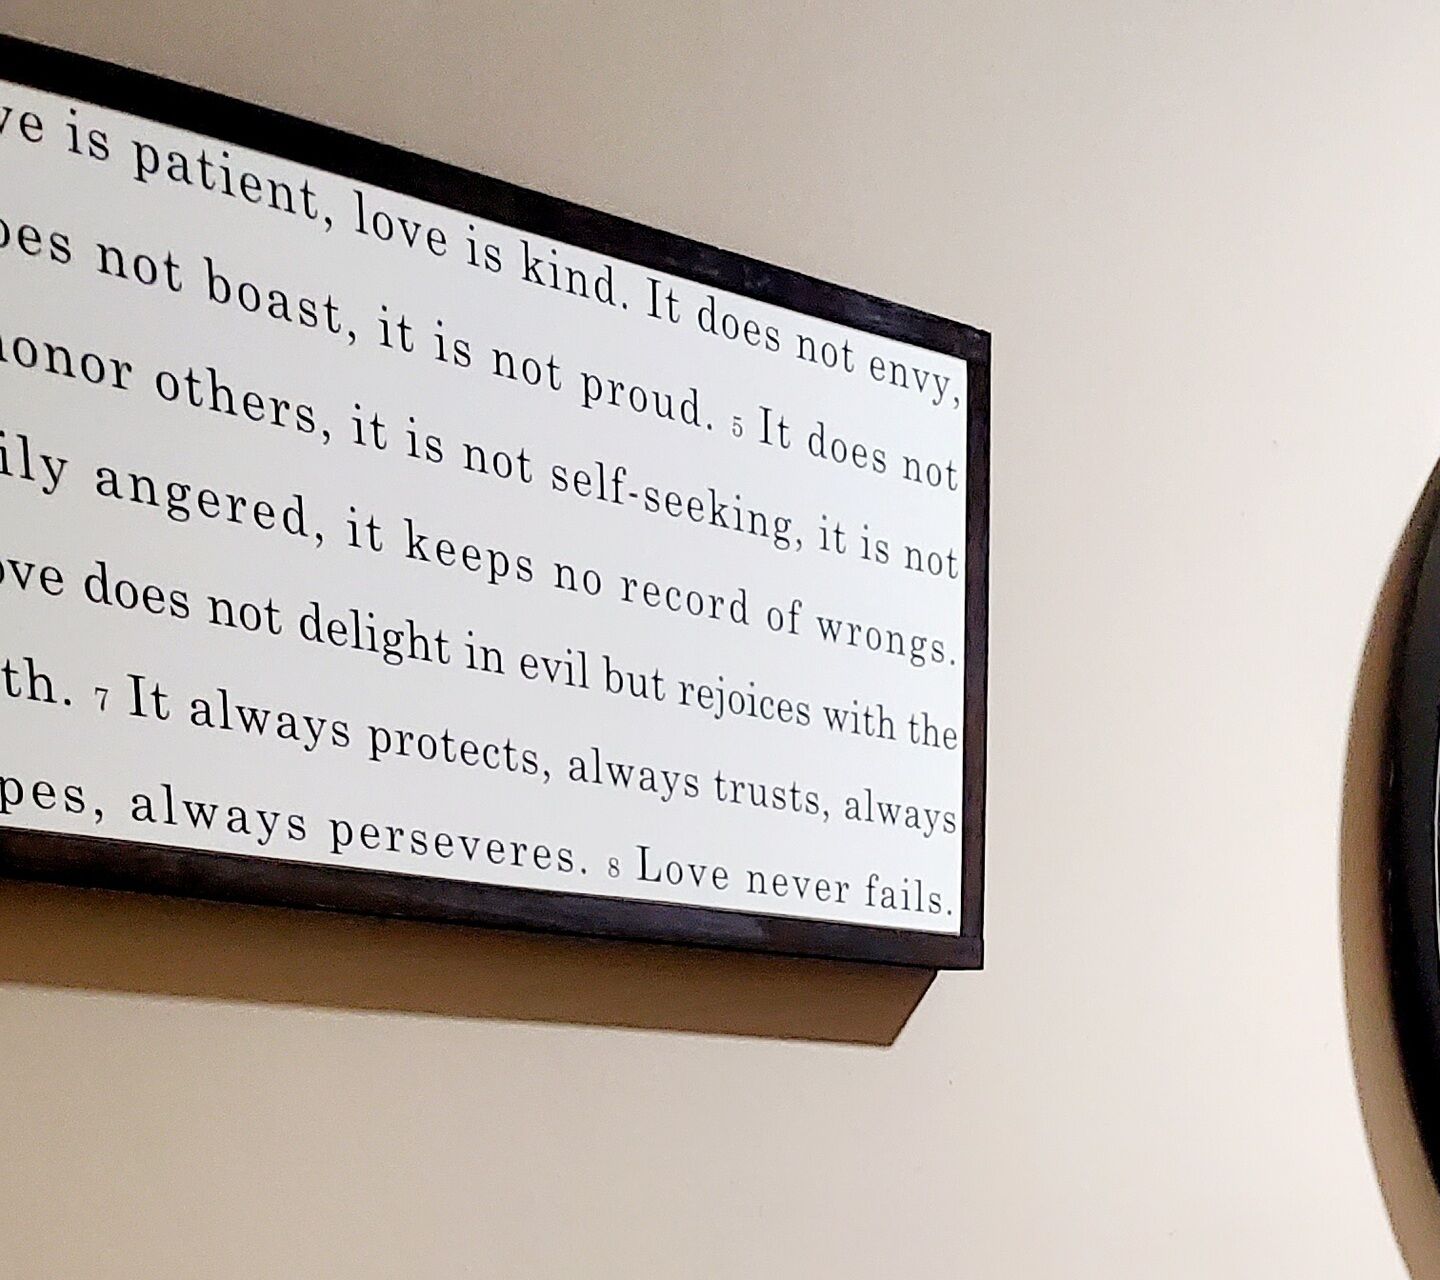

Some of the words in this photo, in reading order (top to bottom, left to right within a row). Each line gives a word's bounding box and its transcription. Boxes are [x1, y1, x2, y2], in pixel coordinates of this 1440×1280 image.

[65, 107, 110, 162] is
[131, 140, 333, 233] patient,
[352, 189, 447, 257] love
[466, 224, 502, 273] is
[519, 239, 628, 310] kind.
[646, 276, 681, 324] It
[697, 294, 780, 352] does
[796, 334, 854, 373] not
[869, 356, 960, 407] envy,
[0, 335, 133, 391] onor
[155, 366, 330, 446] others,
[351, 403, 388, 451] it
[406, 416, 444, 464] is
[462, 443, 533, 484] not
[551, 460, 802, 552] self-seeking,
[820, 514, 845, 554] it
[861, 524, 889, 564] is
[905, 546, 957, 579] not
[95, 243, 183, 293] not
[203, 255, 356, 346] boast,
[378, 304, 414, 353] it
[434, 319, 471, 368] is
[491, 348, 562, 391] not
[580, 372, 712, 431] proud.
[732, 415, 743, 438] 5
[759, 405, 791, 449] It
[808, 421, 887, 474] does
[903, 456, 957, 491] not
[0, 558, 64, 597] ve
[84, 560, 190, 619] does
[207, 596, 283, 635] not
[299, 601, 451, 666] delight
[464, 630, 505, 675] in
[520, 648, 590, 689] evil
[602, 654, 666, 702] but
[678, 675, 810, 726] rejoices
[823, 700, 896, 740] with
[908, 712, 957, 750] the
[96, 467, 324, 549] angered,
[346, 505, 383, 552] it
[403, 517, 533, 586] keeps
[554, 562, 602, 596] no
[620, 576, 749, 626] record
[767, 599, 803, 635] of
[816, 616, 955, 667] wrongs.
[0, 656, 72, 707] th.
[94, 686, 109, 712] 7
[126, 673, 170, 721] It
[190, 687, 350, 752] always
[367, 725, 550, 784] protects,
[569, 747, 699, 803] always
[714, 770, 829, 819] trusts,
[845, 788, 956, 839] always
[0, 775, 103, 825] pes,
[131, 783, 306, 846] always
[328, 819, 587, 875] perseveres.
[608, 857, 620, 878] 8
[636, 845, 728, 890] Love
[746, 870, 850, 904] never
[865, 873, 952, 916] fails.
